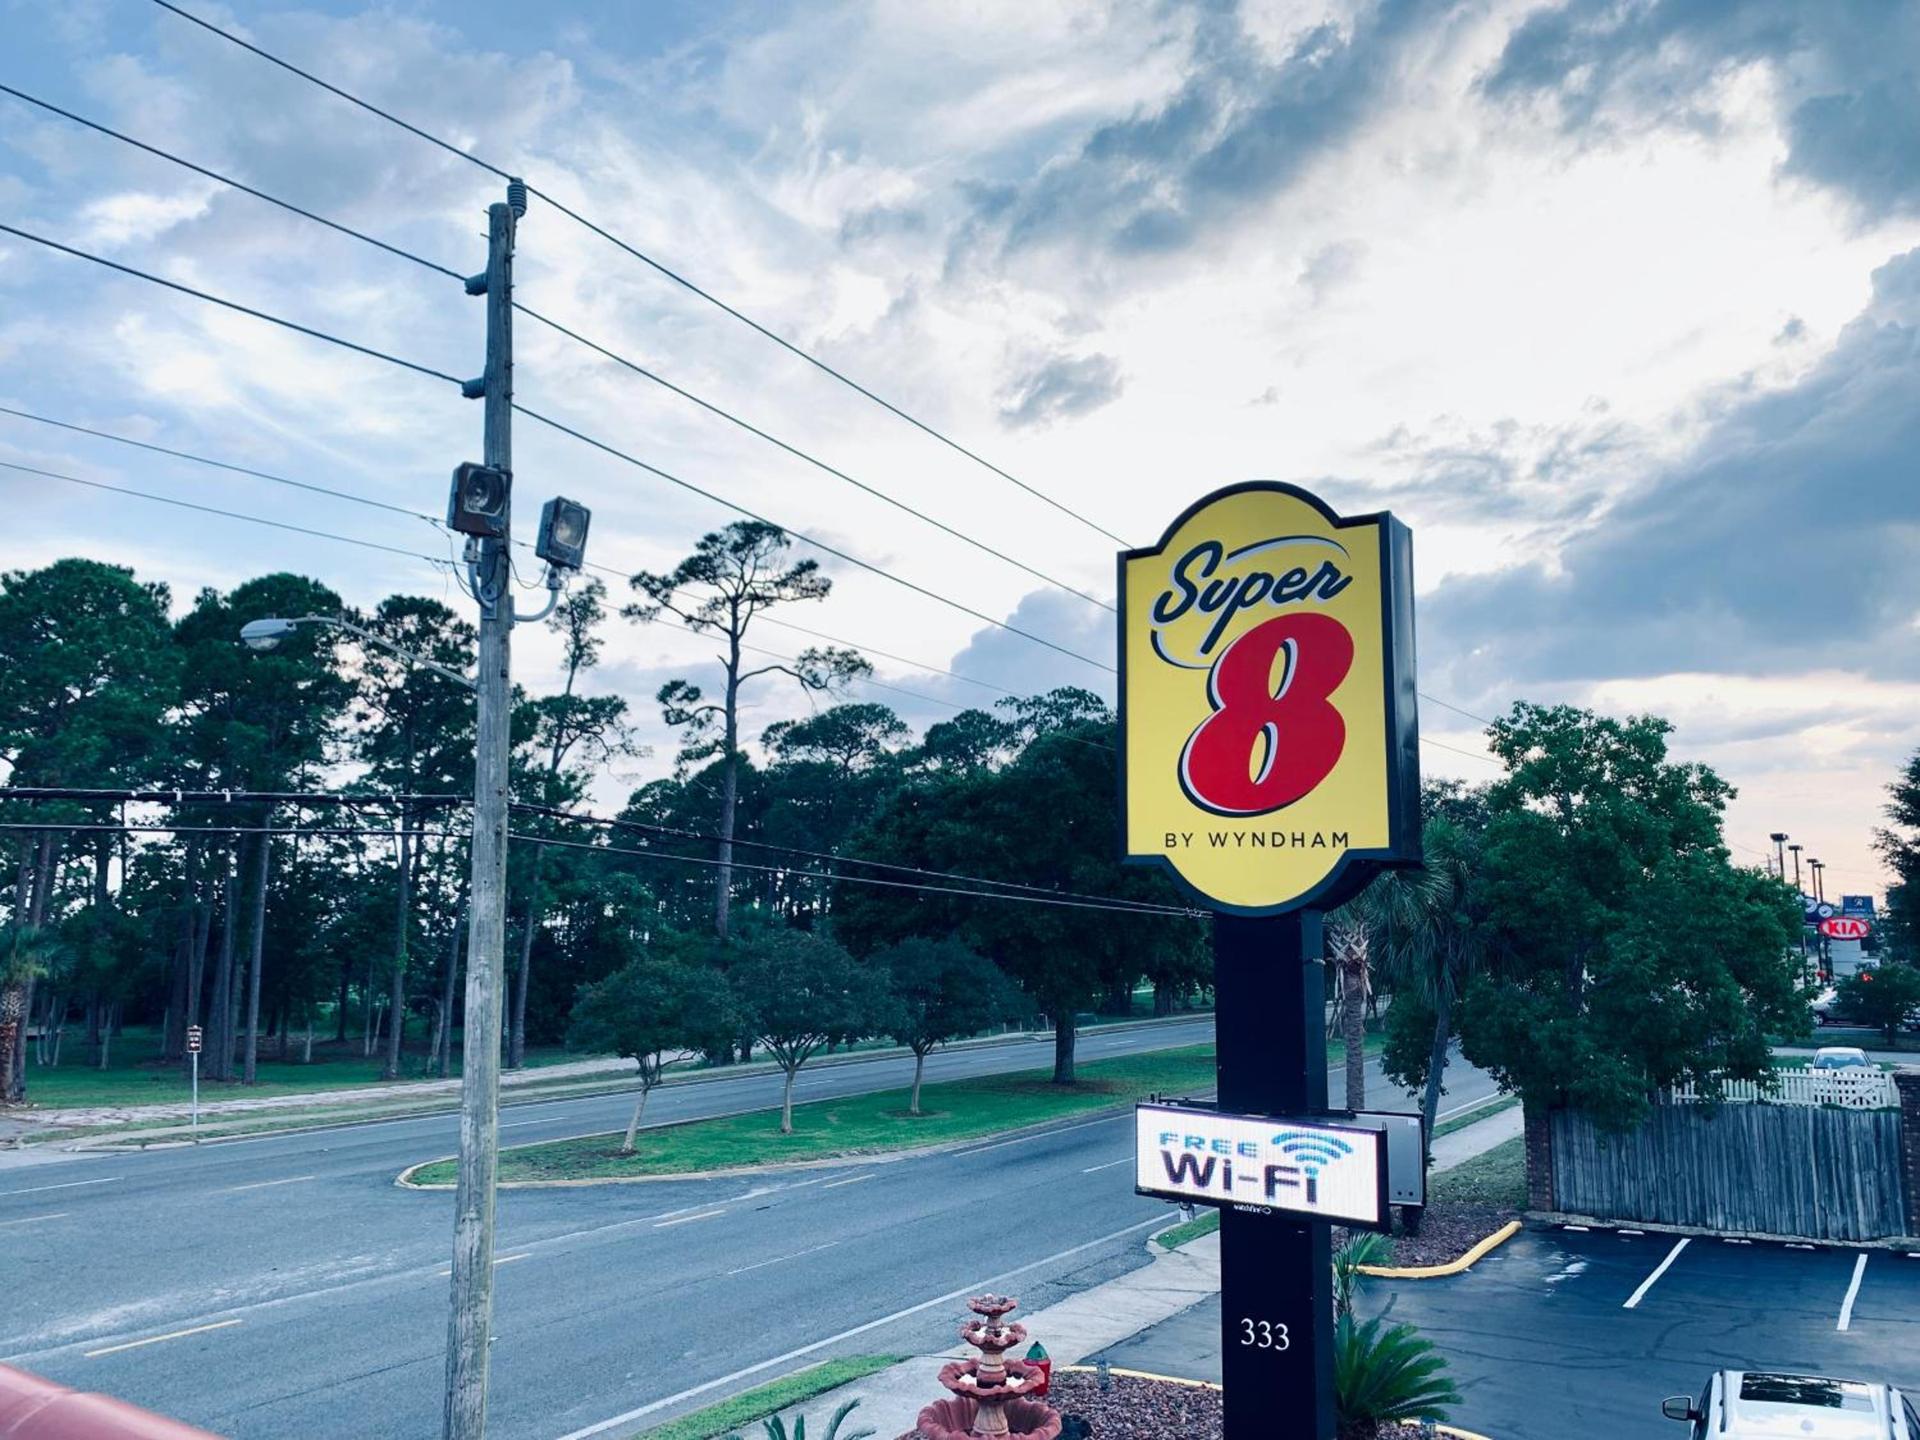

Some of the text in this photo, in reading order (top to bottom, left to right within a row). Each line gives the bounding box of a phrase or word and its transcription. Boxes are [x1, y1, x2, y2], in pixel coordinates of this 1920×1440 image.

[1152, 540, 1354, 655] Super
[1177, 612, 1354, 818] 8
[1165, 832, 1349, 848] BY WYNDHAM
[1828, 921, 1860, 935] KIA
[1159, 1131, 1258, 1158] FREE
[1160, 1150, 1318, 1203] Wi-Fi
[1240, 1317, 1290, 1351] 333
